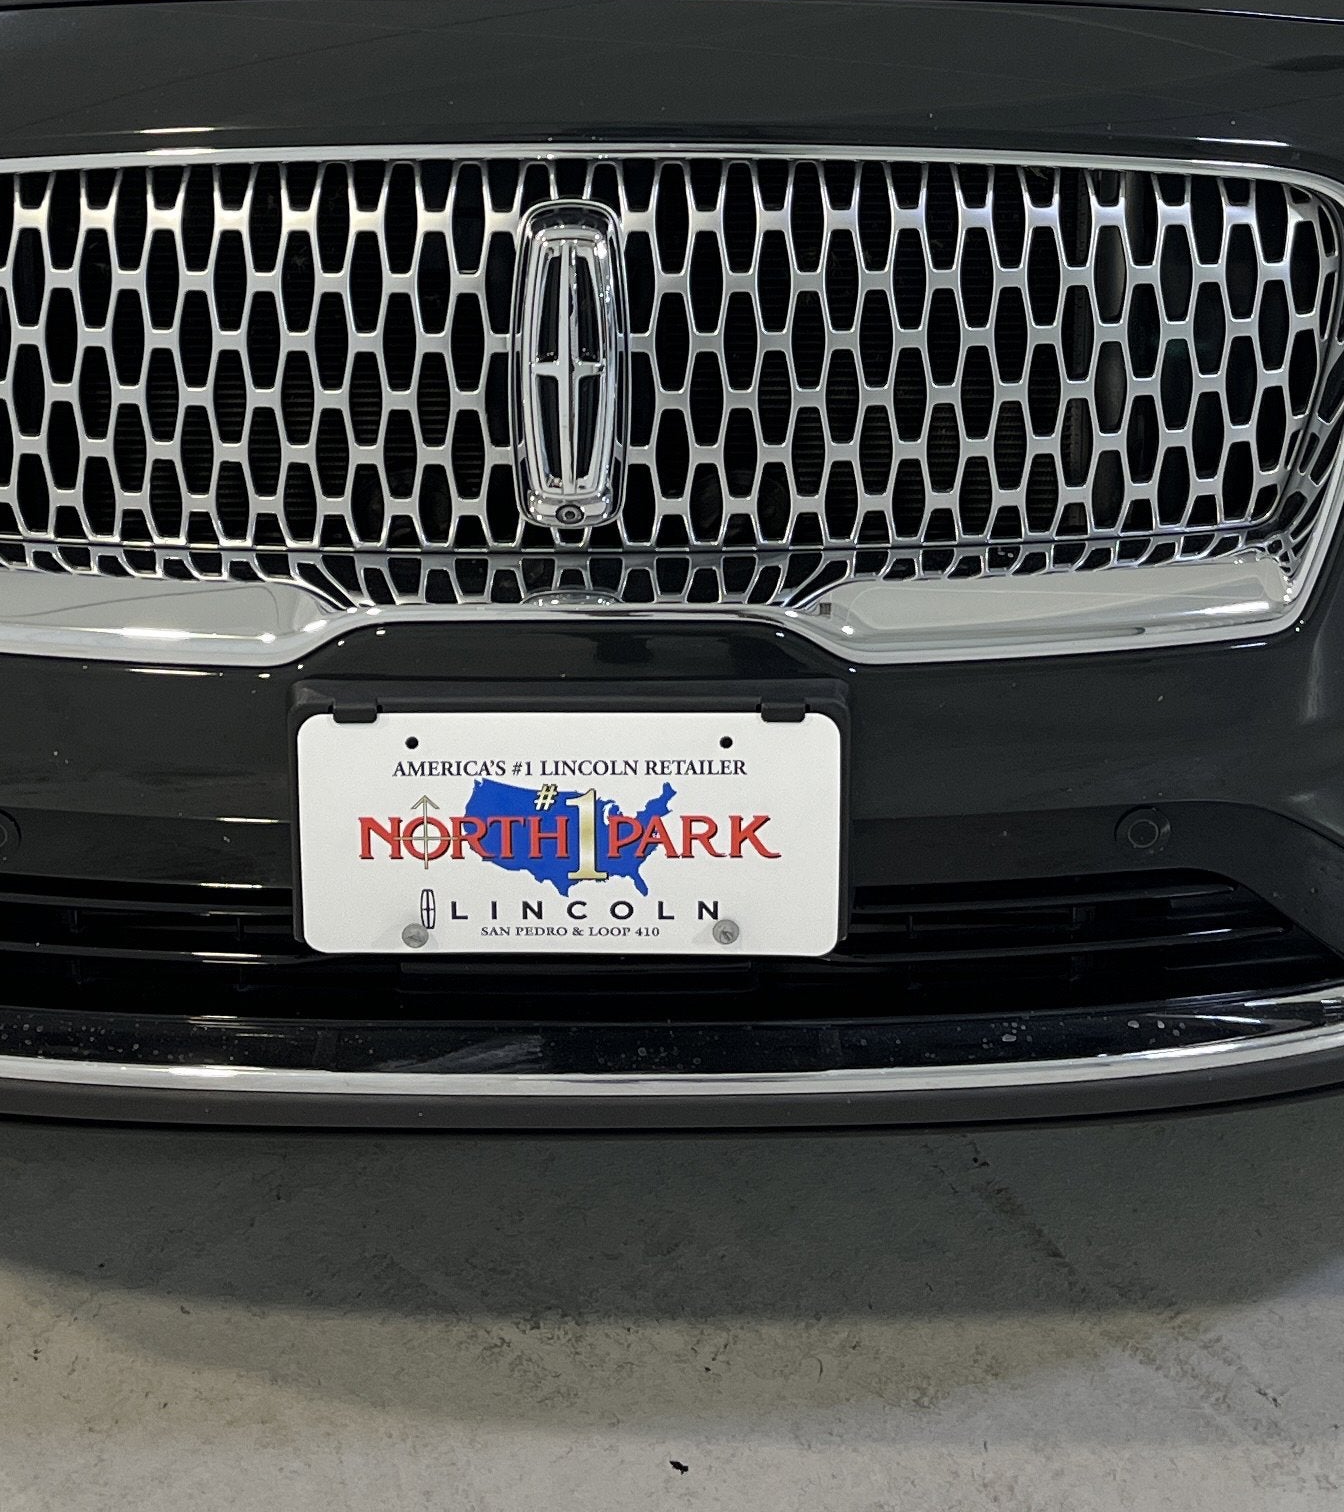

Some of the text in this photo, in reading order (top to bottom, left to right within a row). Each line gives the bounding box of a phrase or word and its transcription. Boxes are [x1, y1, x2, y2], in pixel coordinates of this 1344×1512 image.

[391, 758, 748, 778] AMERICA'S #1 LINCOLN RETAILER
[358, 814, 783, 861] NORTH PARK
[450, 899, 720, 920] LINCOLN
[480, 925, 661, 937] SAN PEDRO & LOOP 410
